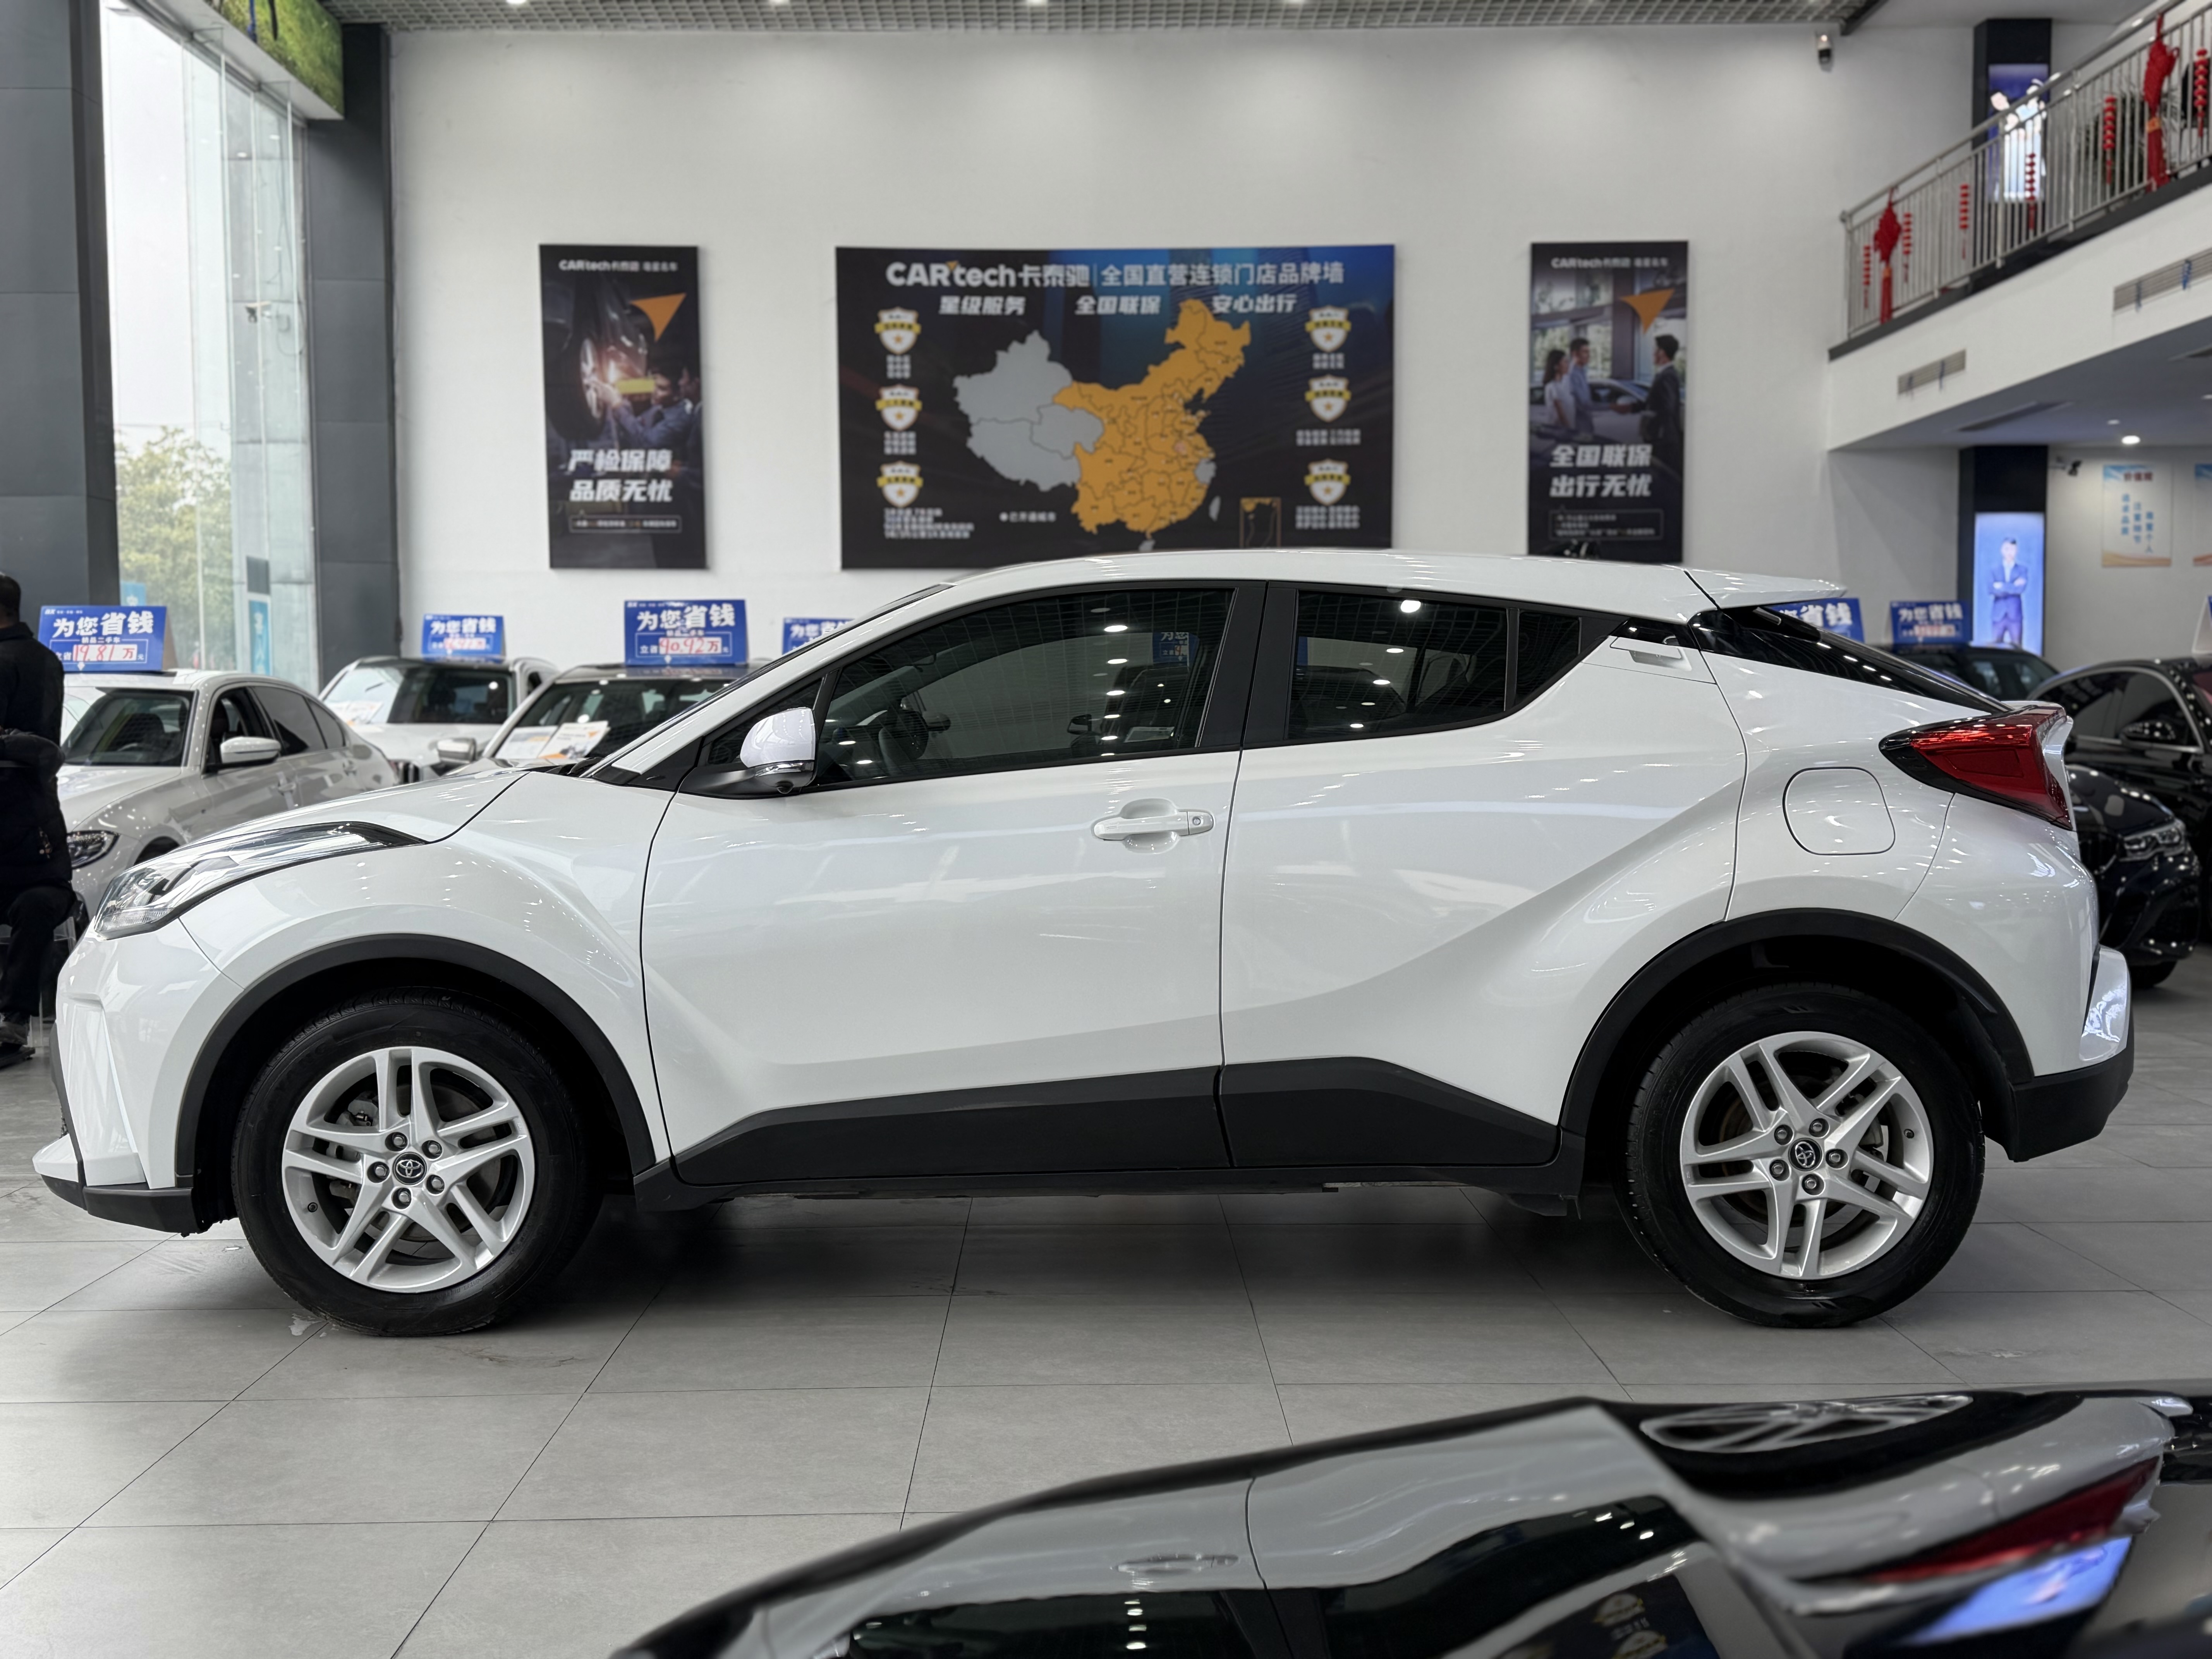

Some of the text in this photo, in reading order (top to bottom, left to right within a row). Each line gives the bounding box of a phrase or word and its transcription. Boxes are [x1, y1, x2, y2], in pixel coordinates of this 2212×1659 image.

[886, 262, 1016, 287] CARtech
[1101, 261, 1344, 287] 全国直营连锁门店品牌墙
[939, 294, 1297, 315] 星级服务 全国联保 安心出行
[568, 449, 672, 472] 严检保障
[1550, 444, 1652, 467] 全国联保
[569, 479, 673, 502] 品质无忧
[1550, 474, 1652, 497] 出行无忧
[52, 610, 154, 638] 为您省钱
[637, 603, 735, 631] 为您省钱
[122, 647, 135, 659] 万
